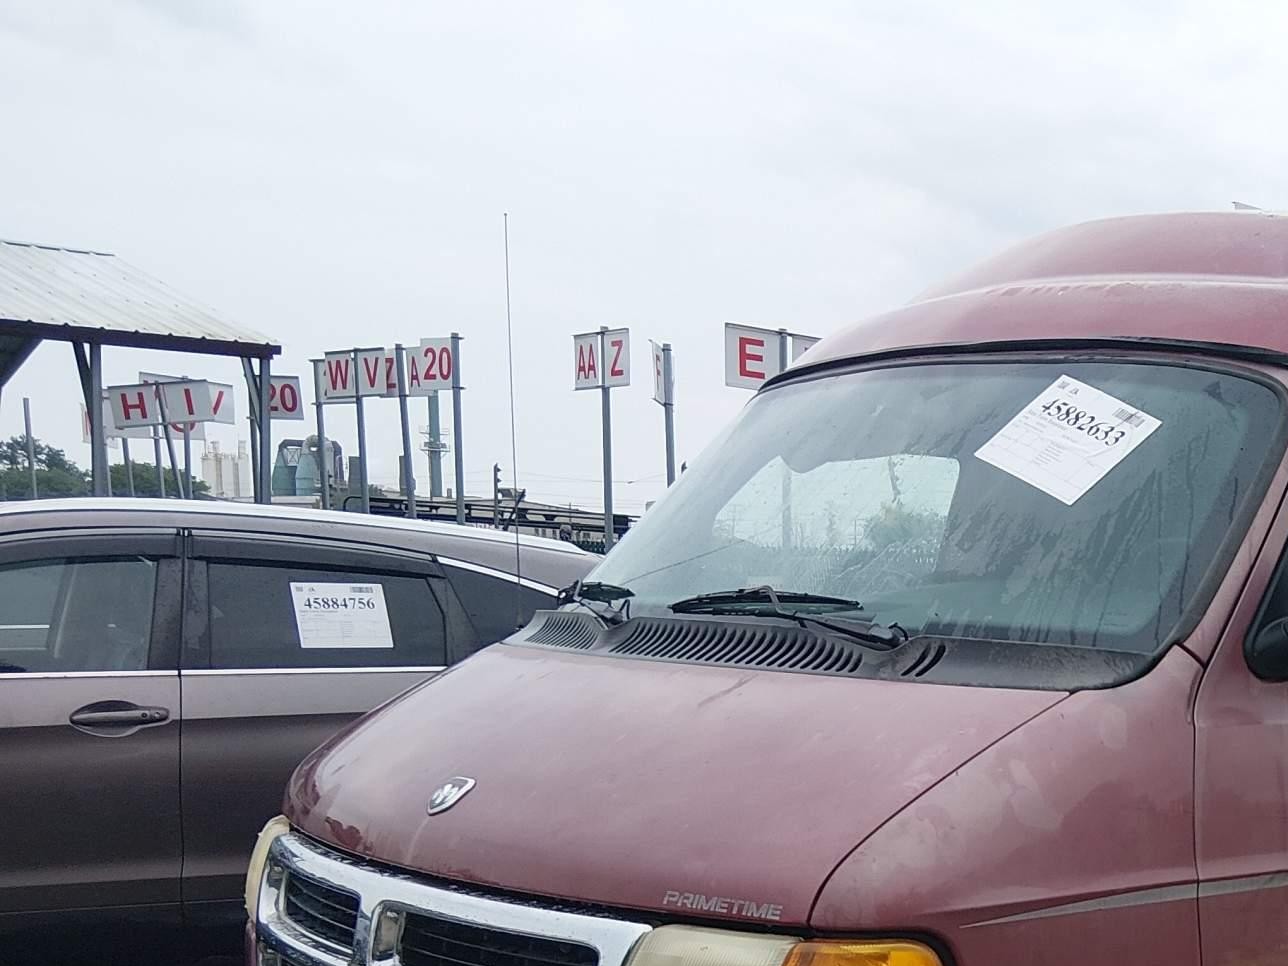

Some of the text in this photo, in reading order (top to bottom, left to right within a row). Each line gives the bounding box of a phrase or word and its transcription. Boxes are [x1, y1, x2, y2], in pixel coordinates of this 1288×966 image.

[363, 357, 379, 388] V
[423, 347, 452, 380] 20
[577, 343, 597, 380] AA
[610, 340, 624, 376] Z
[738, 336, 765, 379] E
[327, 359, 349, 390] W
[120, 391, 148, 420] H
[1040, 398, 1126, 447] 45882633
[304, 597, 375, 609] 45884756
[663, 890, 783, 920] PRIMETIME
